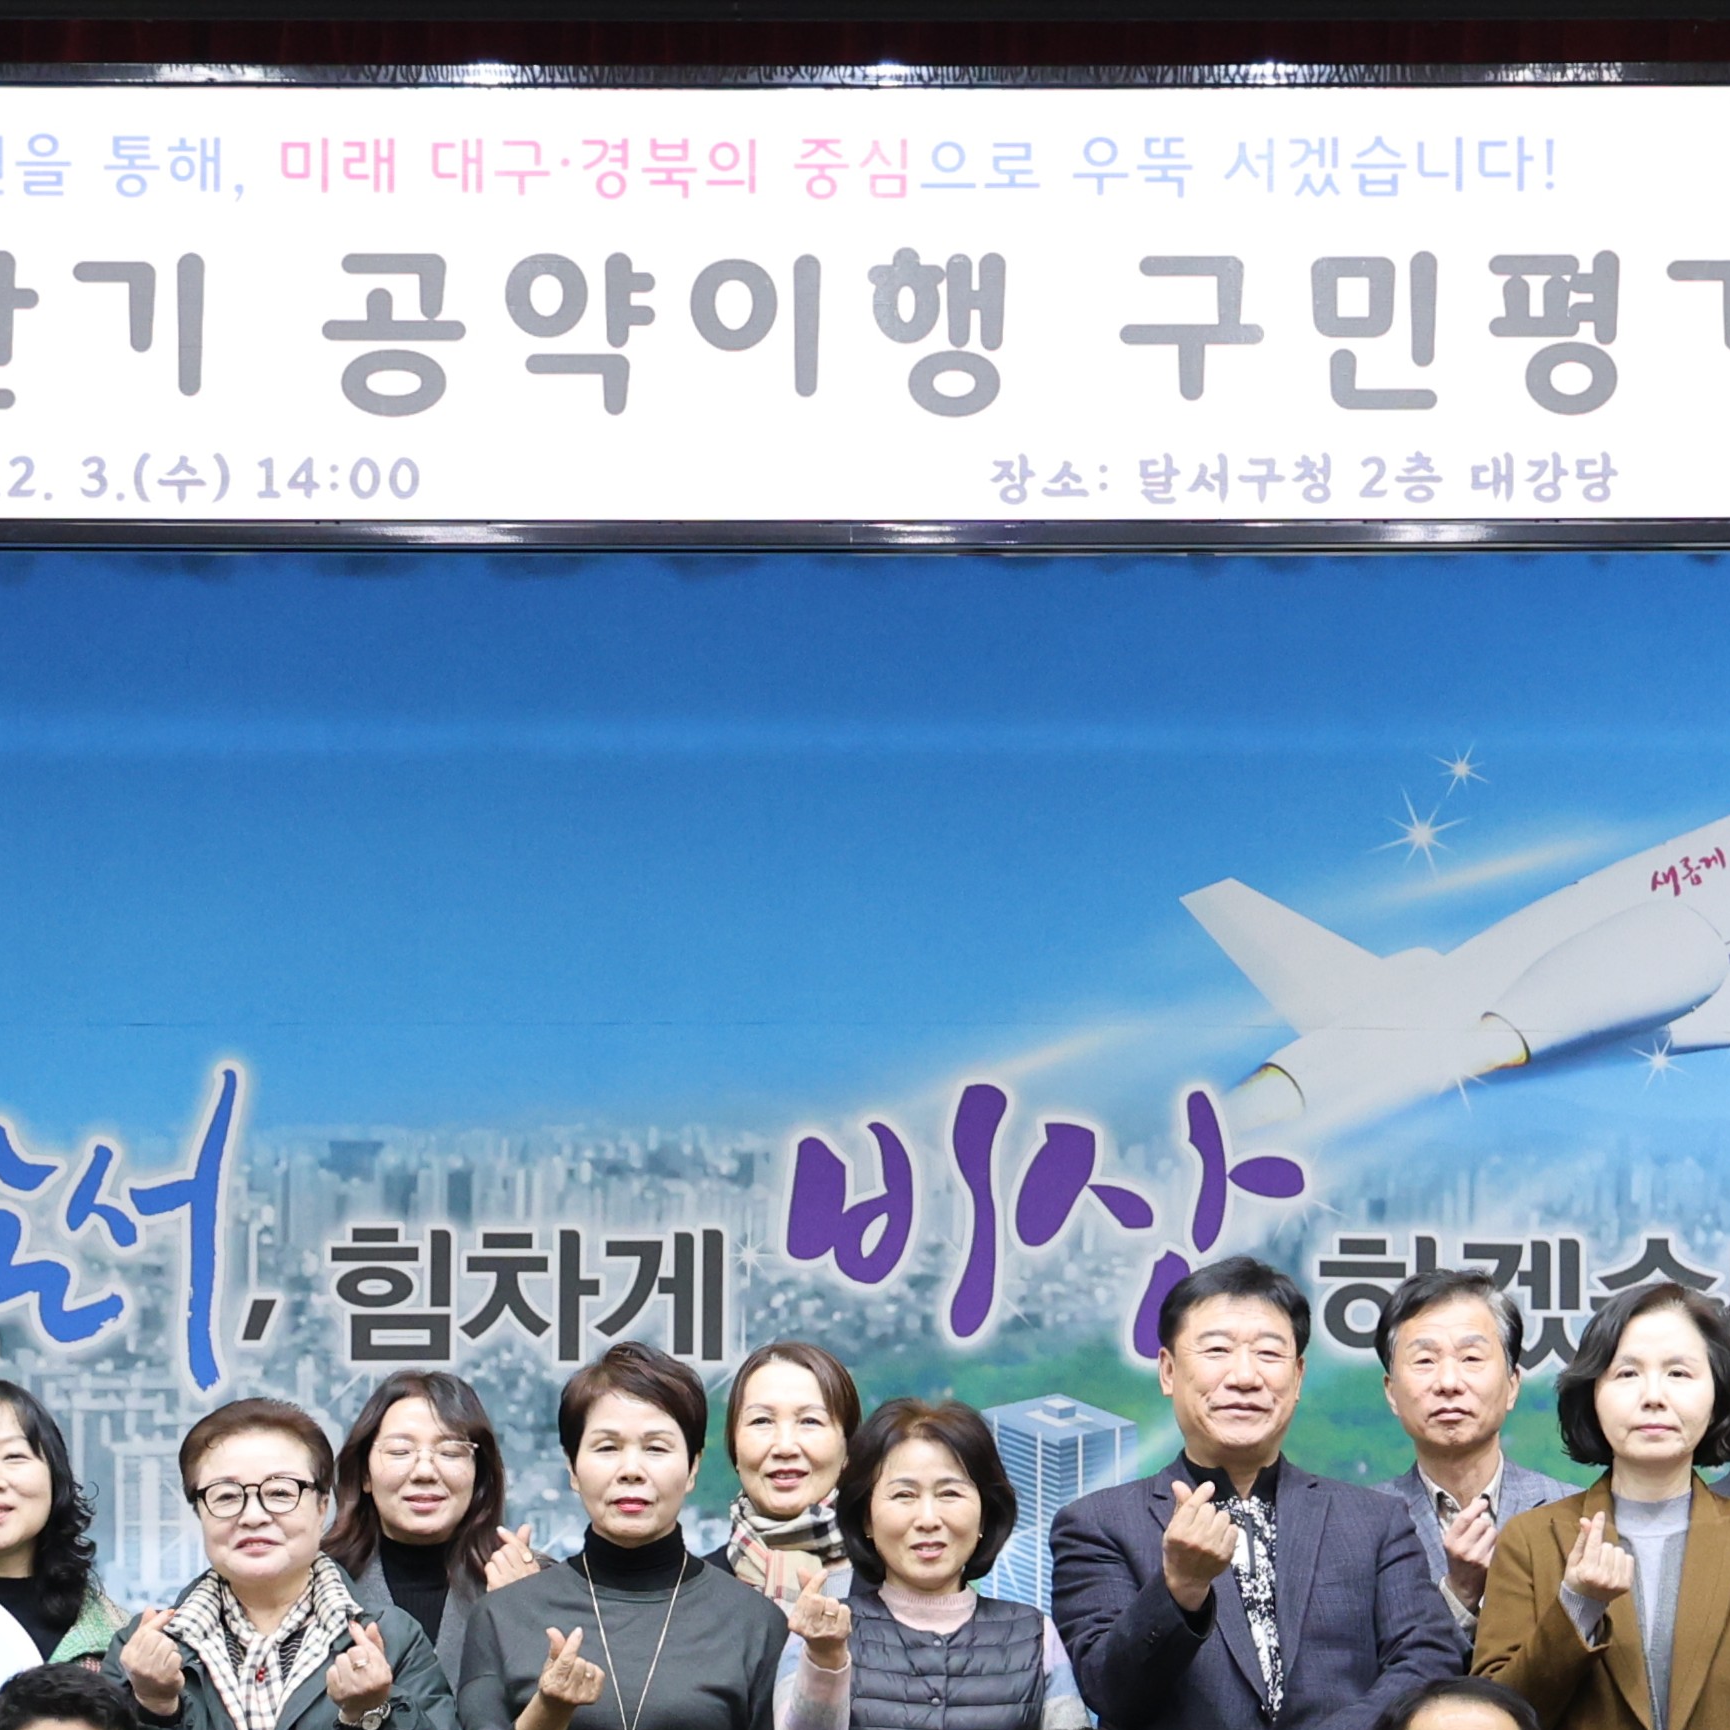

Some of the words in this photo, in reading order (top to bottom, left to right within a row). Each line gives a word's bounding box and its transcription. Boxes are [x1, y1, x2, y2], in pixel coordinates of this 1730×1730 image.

[104, 136, 243, 197] 통해,
[281, 138, 395, 193] 미래
[432, 138, 756, 199] 대구·경북의
[795, 139, 1039, 199] 중심으로
[1073, 137, 1192, 197] 우뚝
[1225, 136, 1554, 196] 서겠습니다!
[322, 247, 1006, 418] 공약이행
[81, 453, 230, 503] 3.(수)
[258, 457, 419, 499] 14:00
[992, 454, 1107, 504] 장소:
[1140, 453, 1331, 504] 달서구청
[1360, 452, 1442, 503] 2층
[1471, 452, 1618, 503] 대강당
[1651, 847, 1726, 897] 새롭게
[328, 1227, 725, 1362] 힘차게
